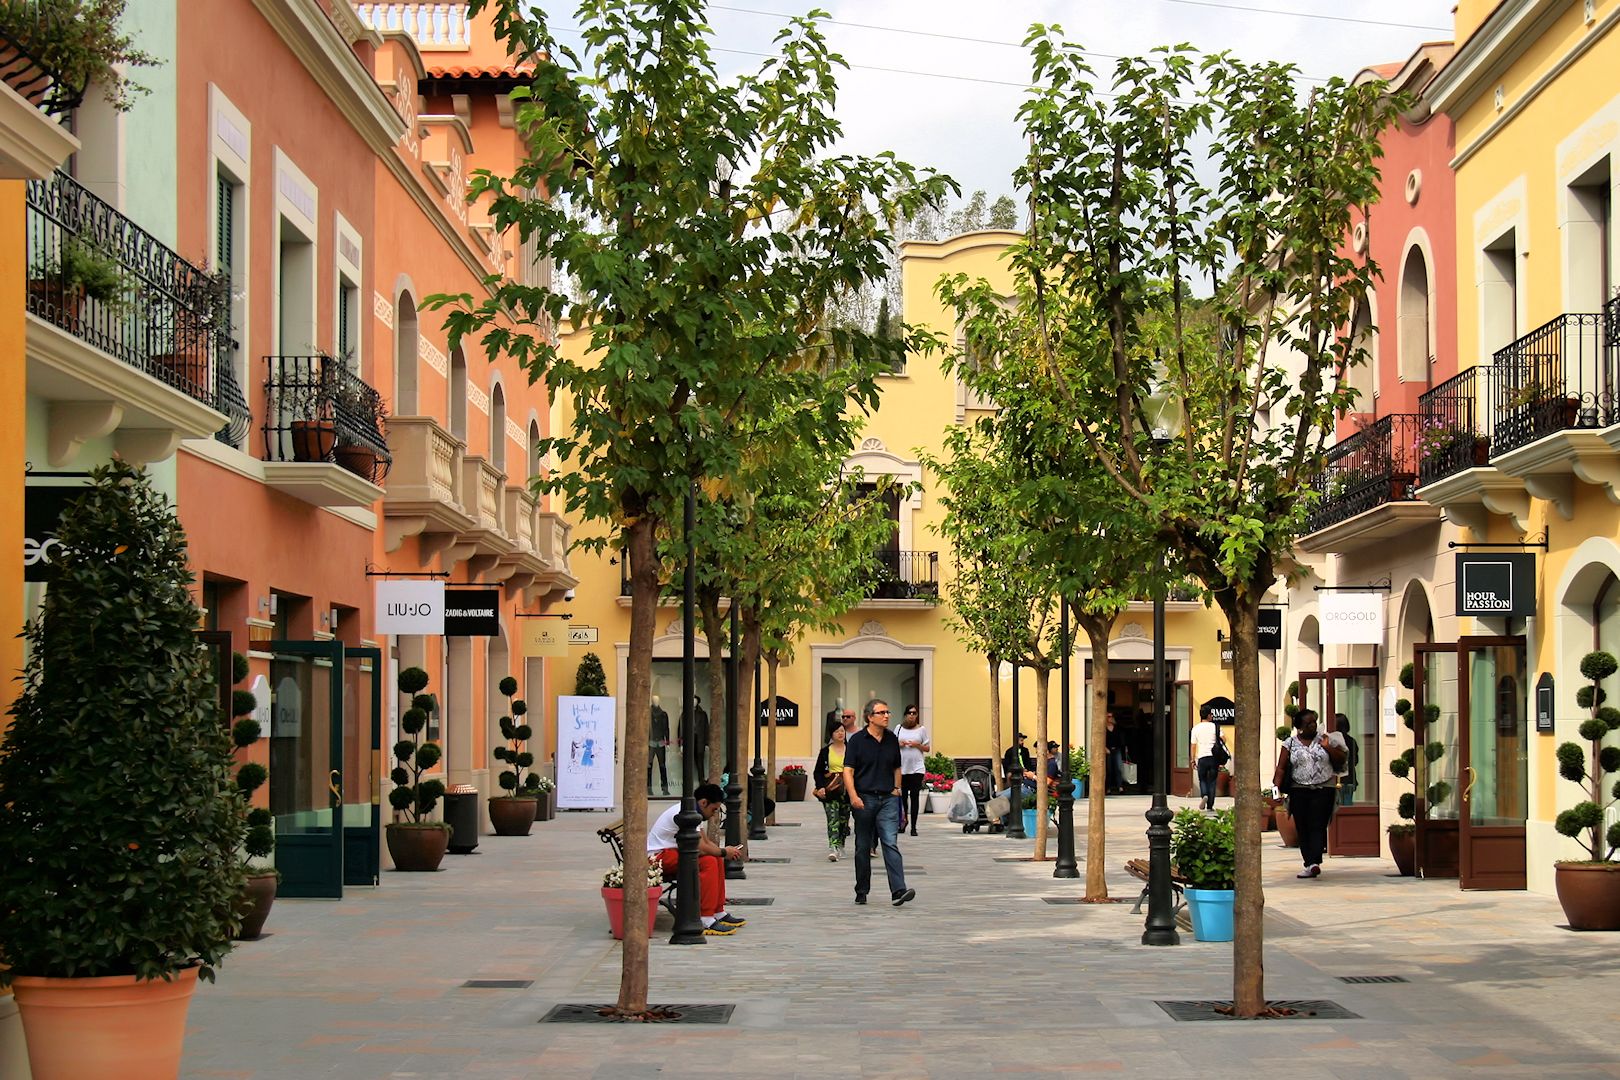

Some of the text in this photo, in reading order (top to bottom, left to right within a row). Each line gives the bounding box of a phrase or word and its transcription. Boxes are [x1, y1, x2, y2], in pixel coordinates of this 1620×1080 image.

[1466, 592, 1497, 601] HOUR
[1466, 600, 1510, 608] PASSION
[1326, 611, 1377, 621] OROGOLD
